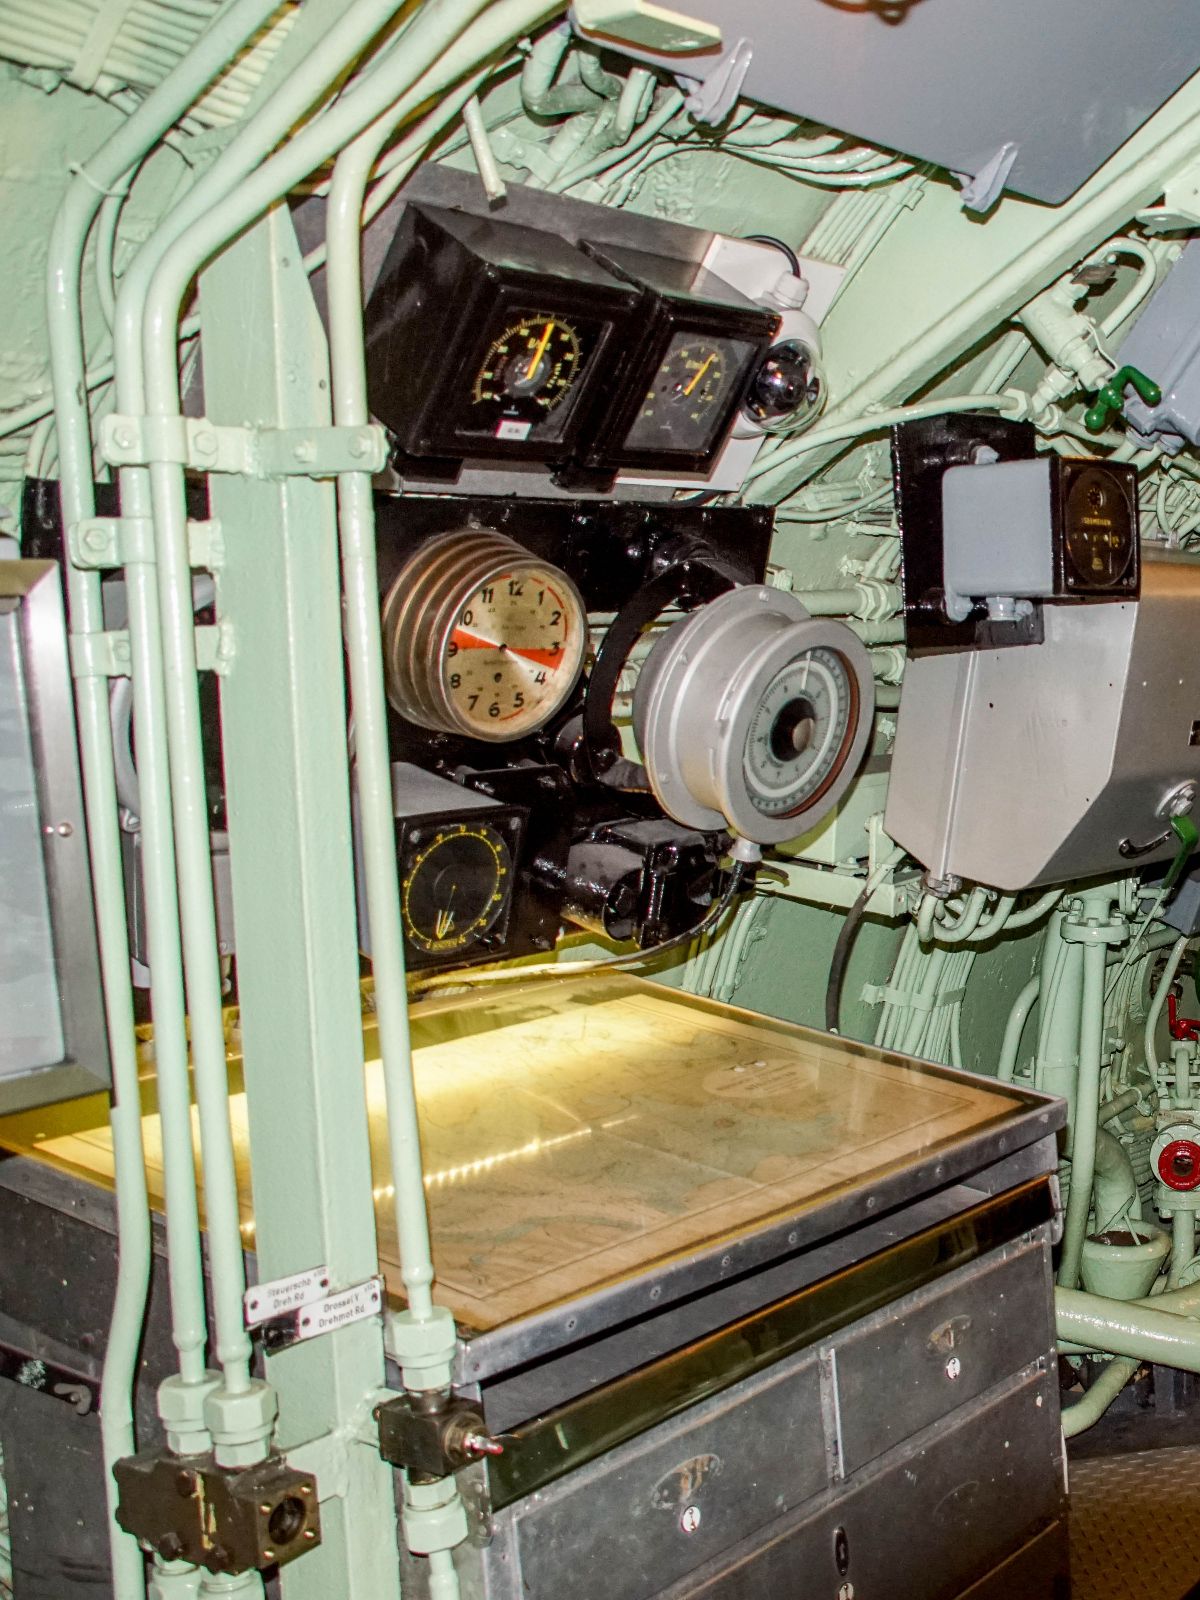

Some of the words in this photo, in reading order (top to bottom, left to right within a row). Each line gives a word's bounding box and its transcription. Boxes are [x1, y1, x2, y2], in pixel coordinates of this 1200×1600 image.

[482, 587, 494, 603] 11
[508, 580, 524, 597] 12
[538, 590, 545, 606] 1
[459, 610, 473, 626] 10
[550, 610, 562, 626] 2
[448, 641, 459, 657] 9
[549, 641, 560, 656] 3
[451, 673, 461, 689] 8
[535, 671, 546, 685] 4
[468, 695, 479, 711] 7
[513, 692, 524, 708] 5
[488, 702, 500, 718] 6
[273, 1296, 292, 1309] Dreh
[294, 1292, 305, 1302] Rd
[323, 1296, 353, 1313] Drossel
[319, 1309, 353, 1328] Drehmot
[355, 1304, 366, 1316] Rd
